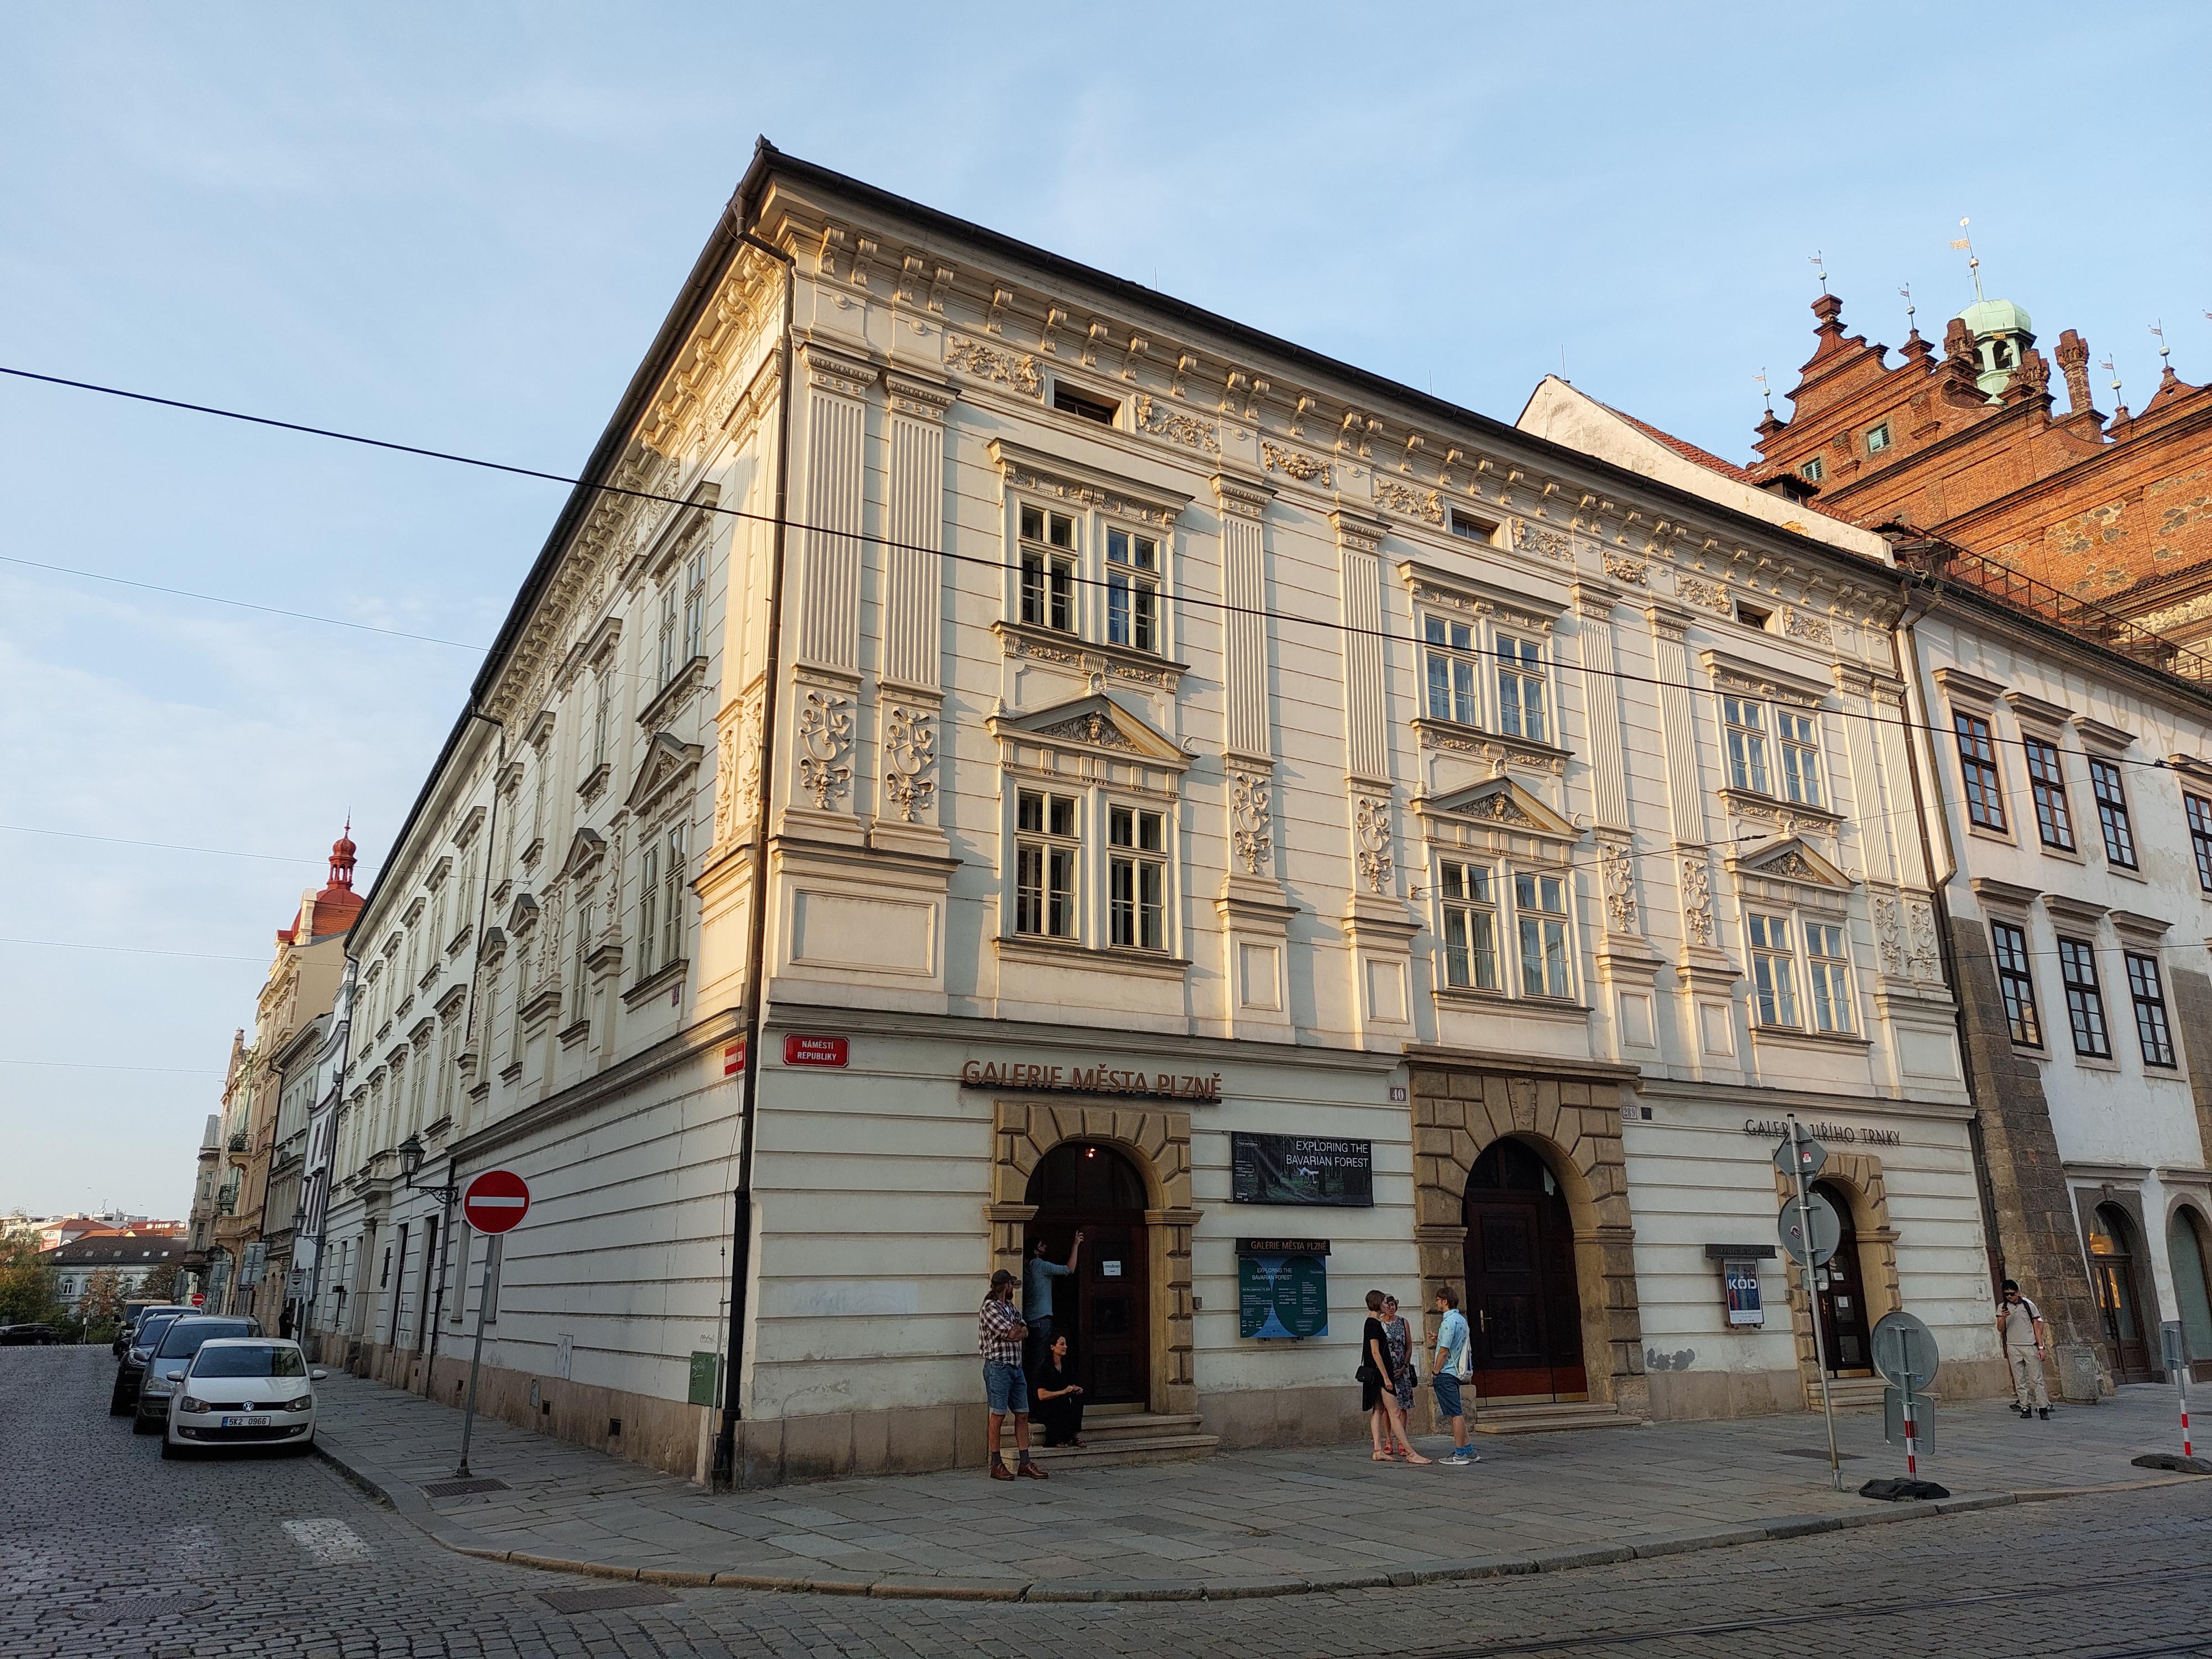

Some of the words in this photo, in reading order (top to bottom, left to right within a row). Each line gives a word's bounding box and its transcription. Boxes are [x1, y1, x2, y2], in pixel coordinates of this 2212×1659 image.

[802, 1040, 834, 1050] NÁMĚSTÍ
[797, 1052, 837, 1061] REPUBLIKY
[962, 1060, 1063, 1089] GALERIE
[1073, 1063, 1149, 1094] MĚSTA
[1157, 1072, 1223, 1100] PLZNĚ
[1392, 1088, 1404, 1100] 40
[1624, 1107, 1635, 1117] 289
[1744, 1119, 1802, 1137] GALER
[1809, 1121, 1855, 1143] JIŘÍHO
[1860, 1128, 1901, 1146] TRNKY
[1296, 1141, 1348, 1152] EXPLORING
[1350, 1144, 1369, 1154] THE
[1286, 1155, 1332, 1166] BAVARIAN
[1334, 1157, 1369, 1167] FOREST
[1251, 1241, 1280, 1250] GALERIE
[1282, 1240, 1305, 1250] MĚSTA
[1307, 1241, 1327, 1250] PLZNĚ
[1729, 1276, 1757, 1290] KÓD
